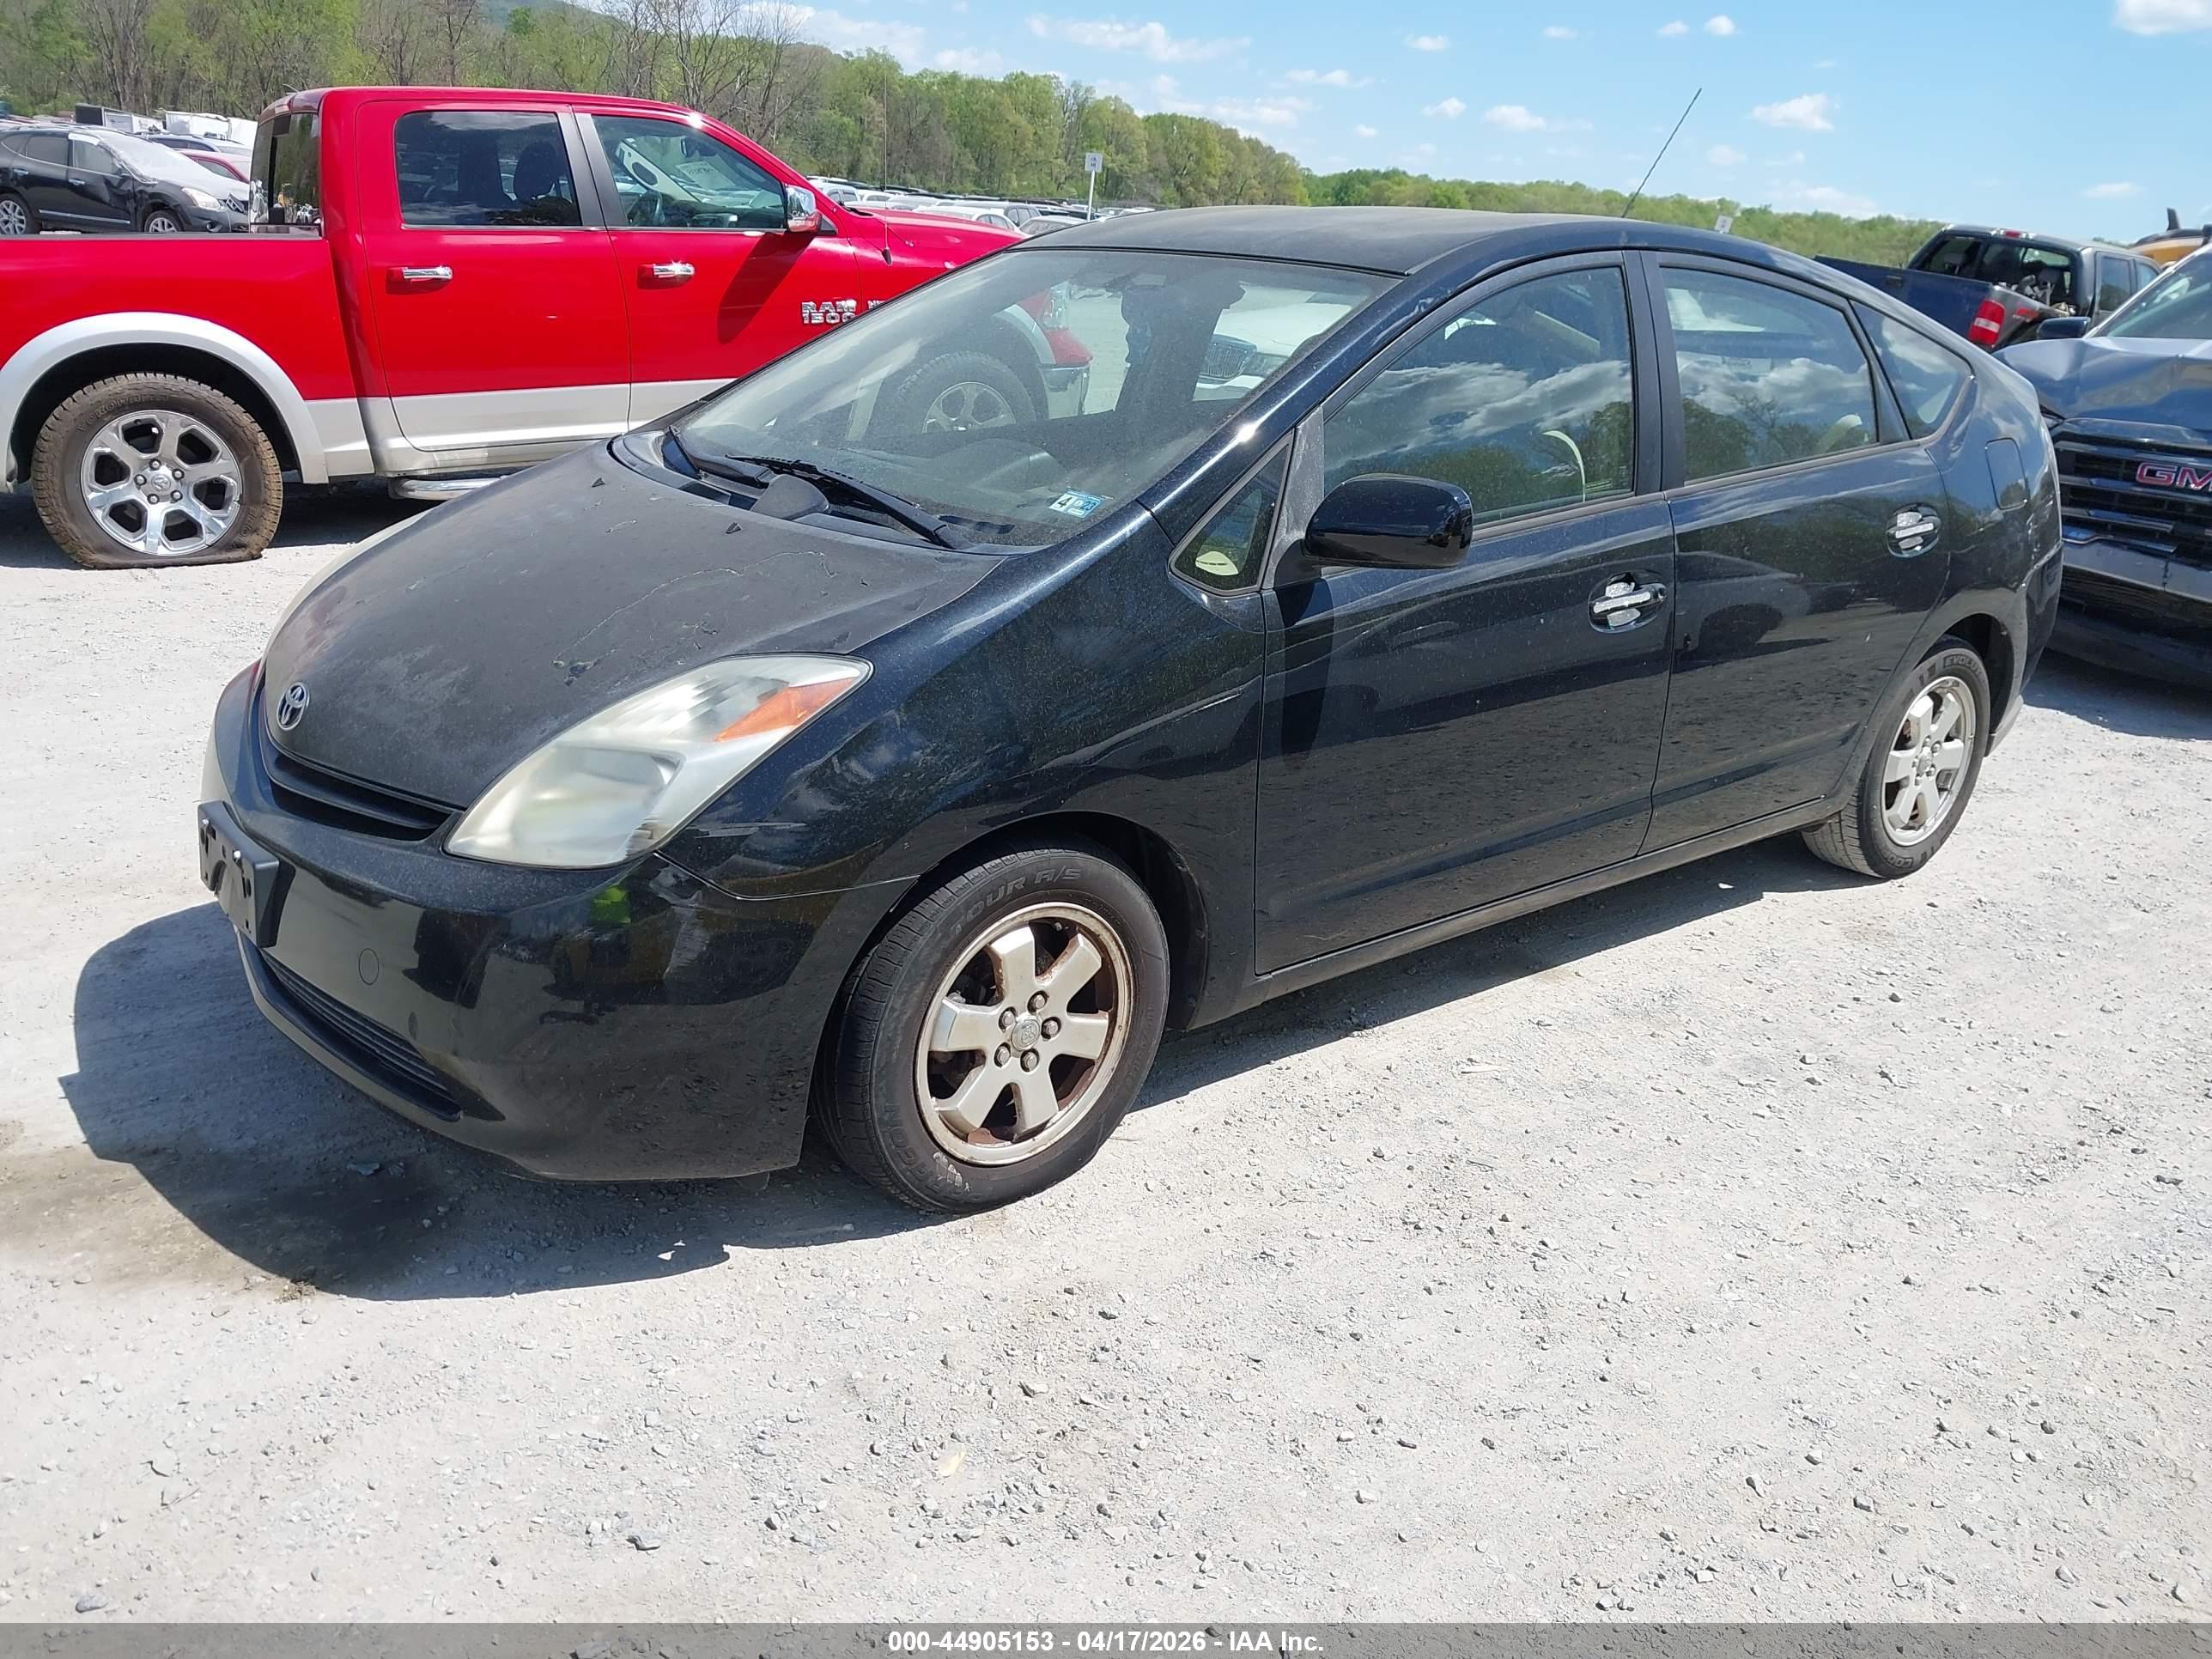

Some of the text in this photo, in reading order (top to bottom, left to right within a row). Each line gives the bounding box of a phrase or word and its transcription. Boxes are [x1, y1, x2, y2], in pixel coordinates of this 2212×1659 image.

[801, 301, 857, 312] RAM
[802, 313, 856, 324] 1500
[1058, 497, 1097, 511] 4 23
[950, 865, 1082, 935] TOUR A/S
